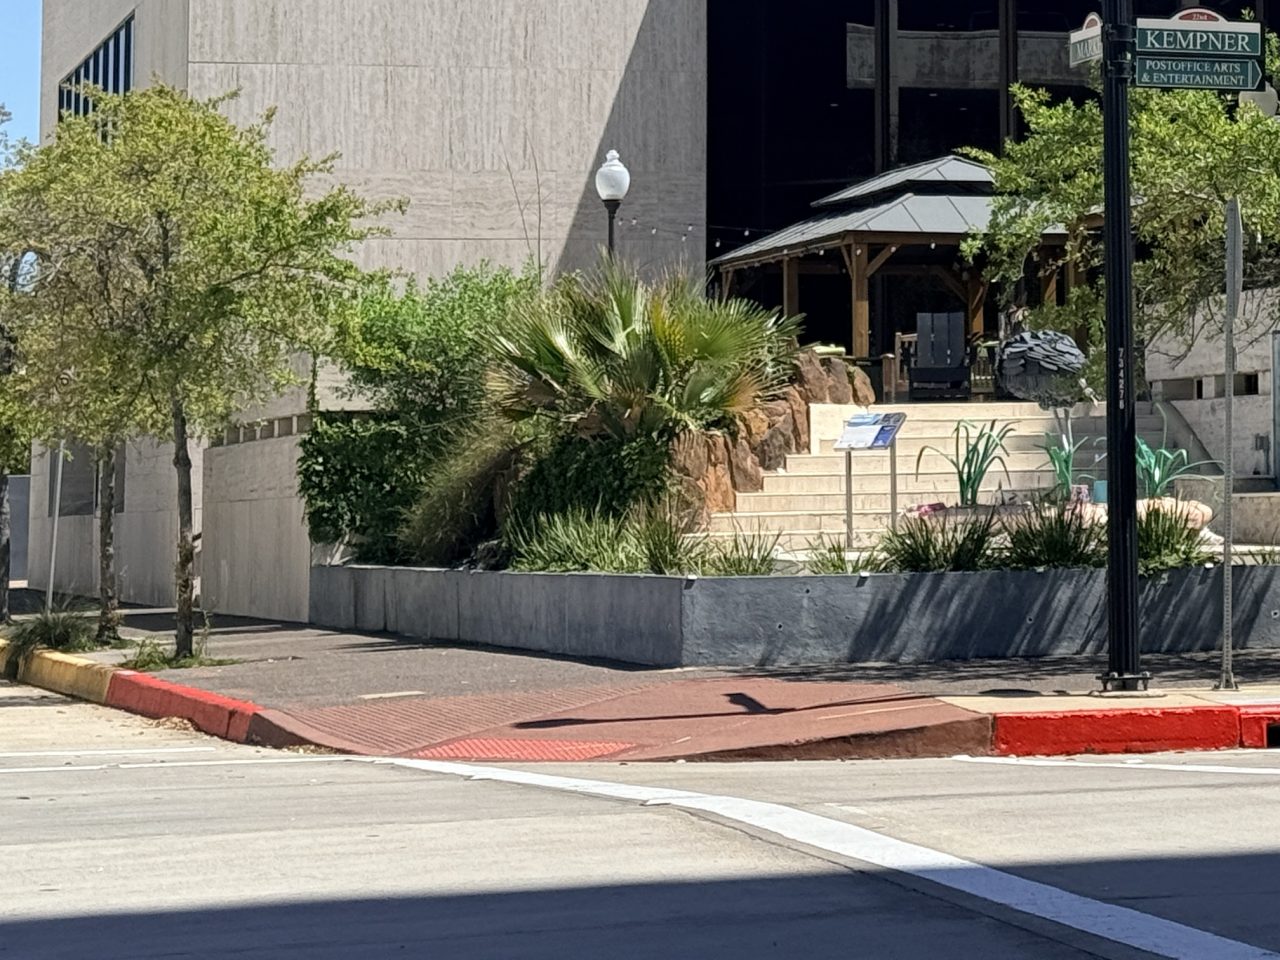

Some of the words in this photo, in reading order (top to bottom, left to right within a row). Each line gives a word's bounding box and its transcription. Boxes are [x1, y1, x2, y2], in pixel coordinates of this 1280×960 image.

[1145, 30, 1251, 52] KEMPNER
[1145, 59, 1211, 72] POSTOFFICE
[1213, 62, 1241, 73] ARTS
[1141, 73, 1151, 83] &
[1152, 73, 1245, 86] ENTERTAINMENT
